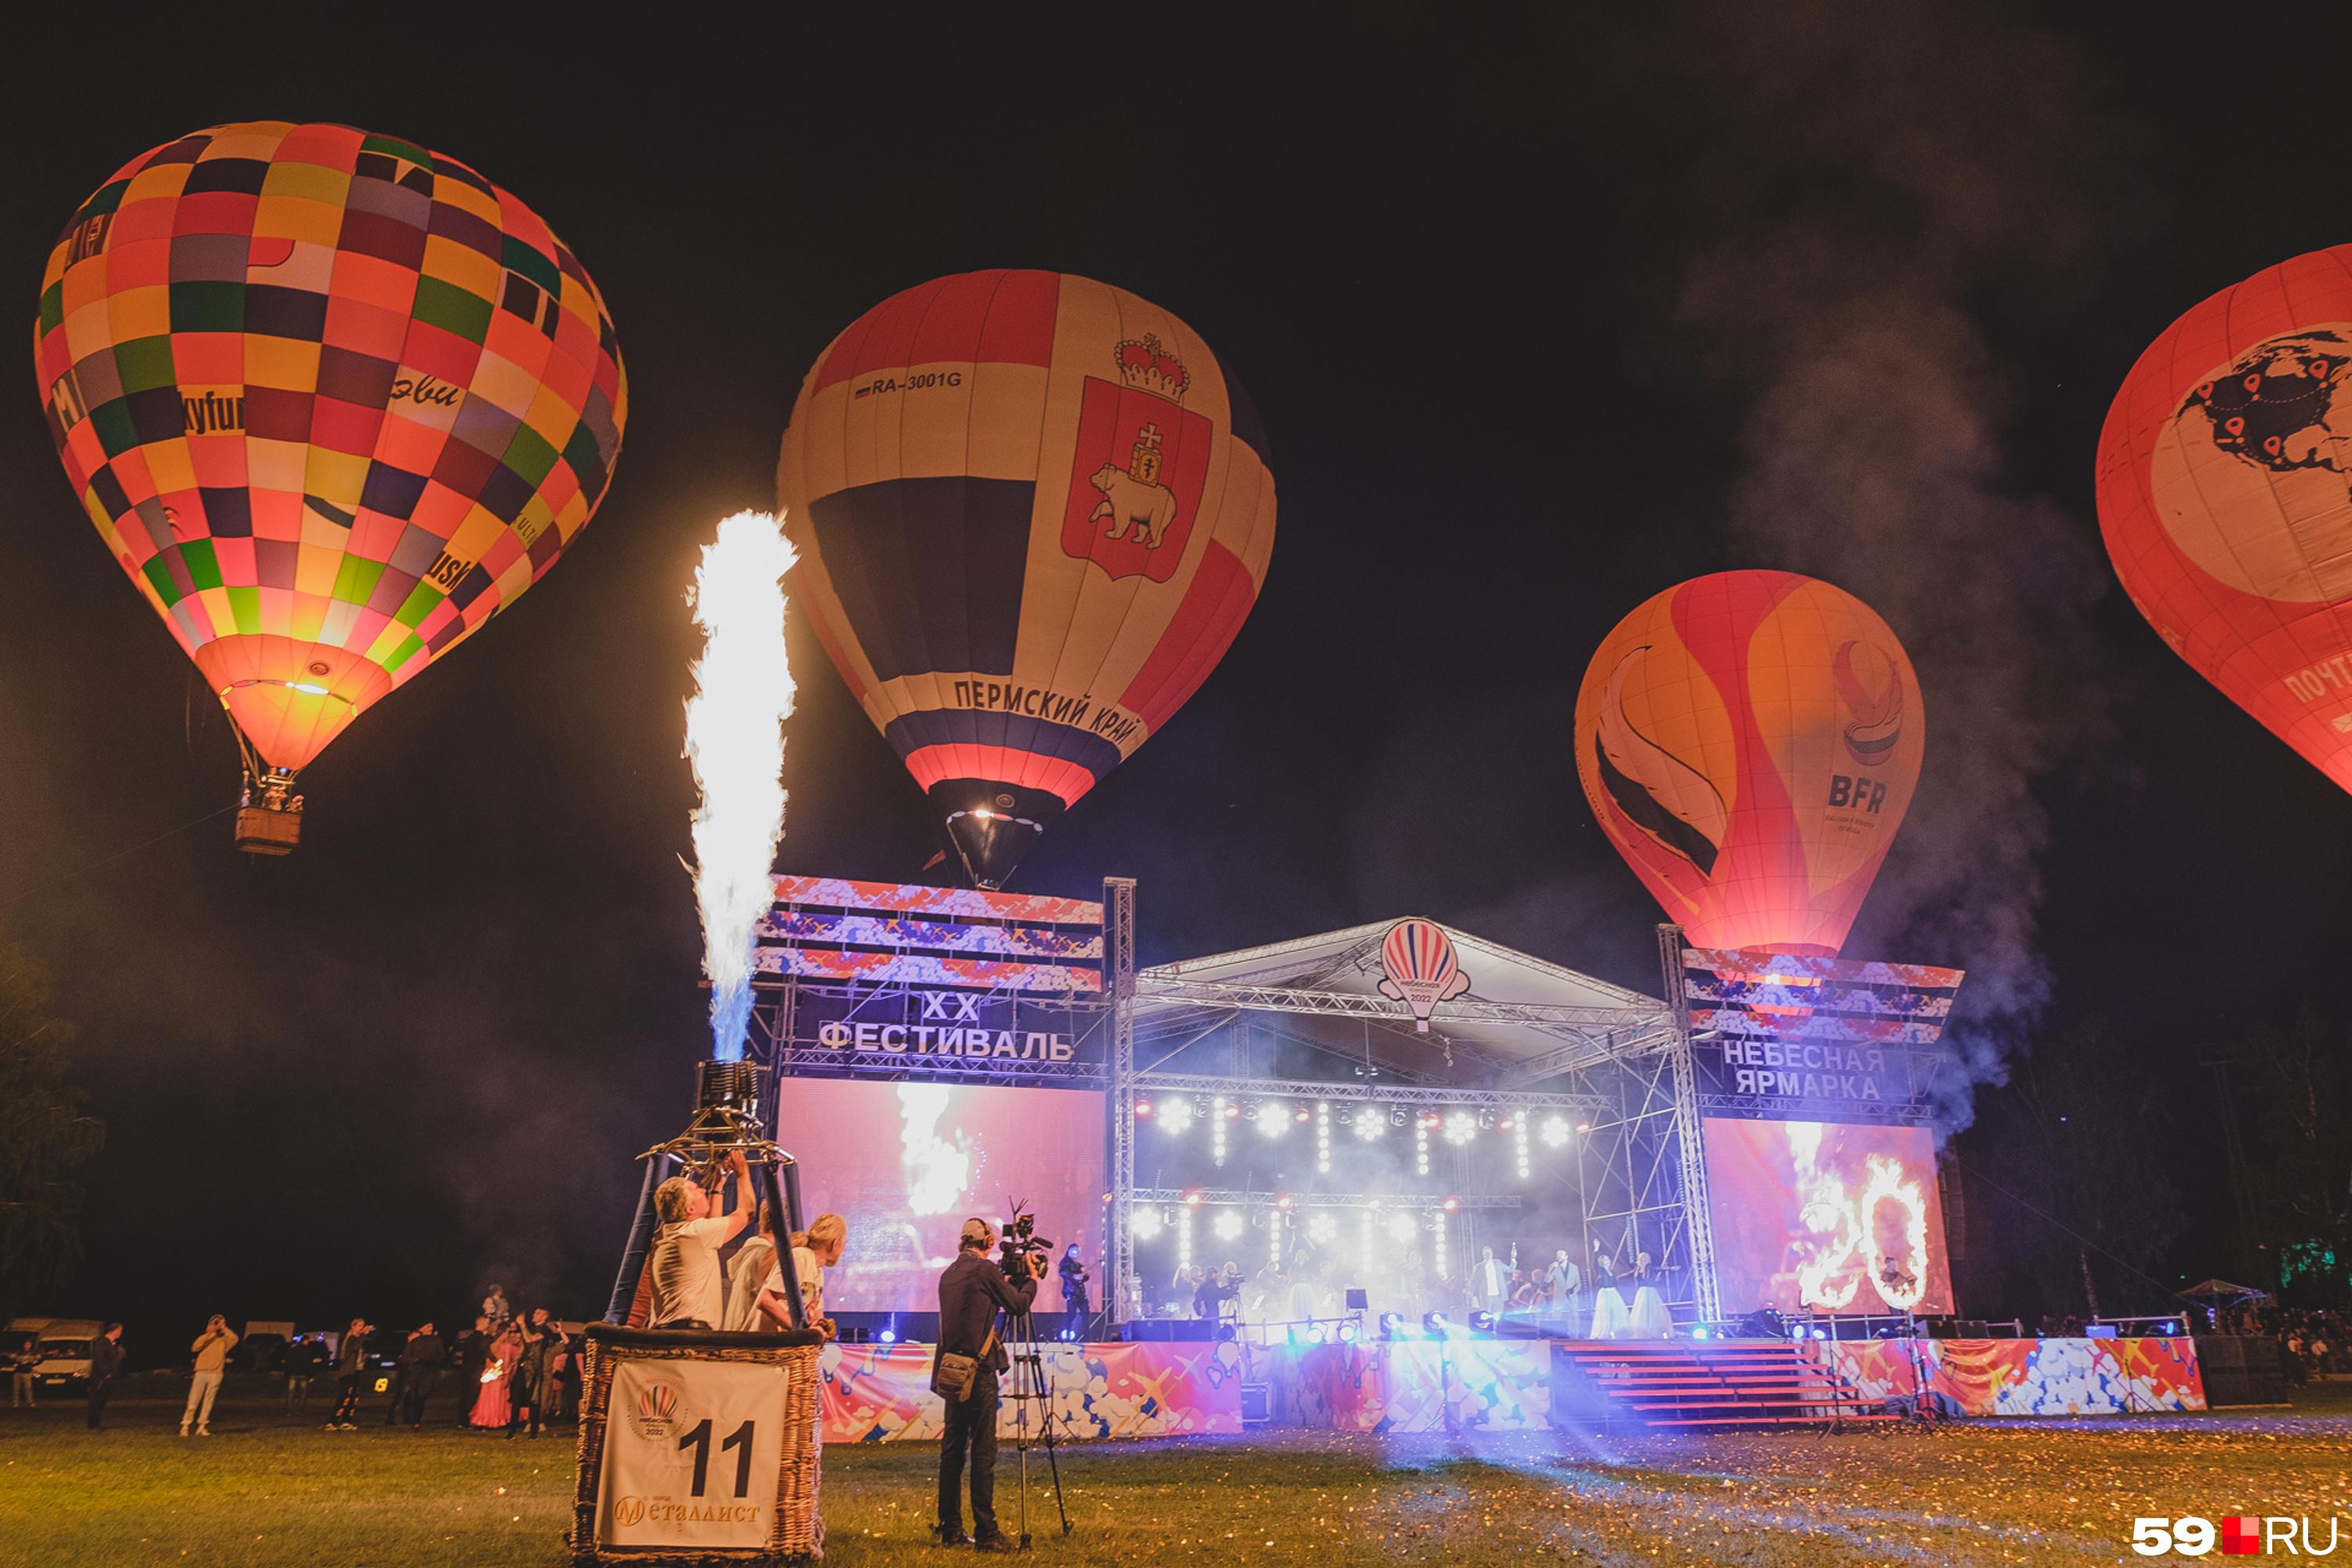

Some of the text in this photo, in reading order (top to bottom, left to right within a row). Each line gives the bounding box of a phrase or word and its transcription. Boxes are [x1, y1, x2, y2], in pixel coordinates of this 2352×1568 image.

[872, 372, 962, 394] RA-3001G
[2283, 652, 2352, 703] ПОЧТ
[954, 681, 1142, 745] ПЕРМСКИЙ КРАЙ
[1828, 775, 1887, 814] BFR
[819, 1021, 1075, 1062] ФЕСТИВАЛЬ
[1724, 1040, 1886, 1073] НЕБЕСНАЯ
[1736, 1069, 1881, 1100] ЯРМАРКА
[678, 1419, 755, 1497] 11
